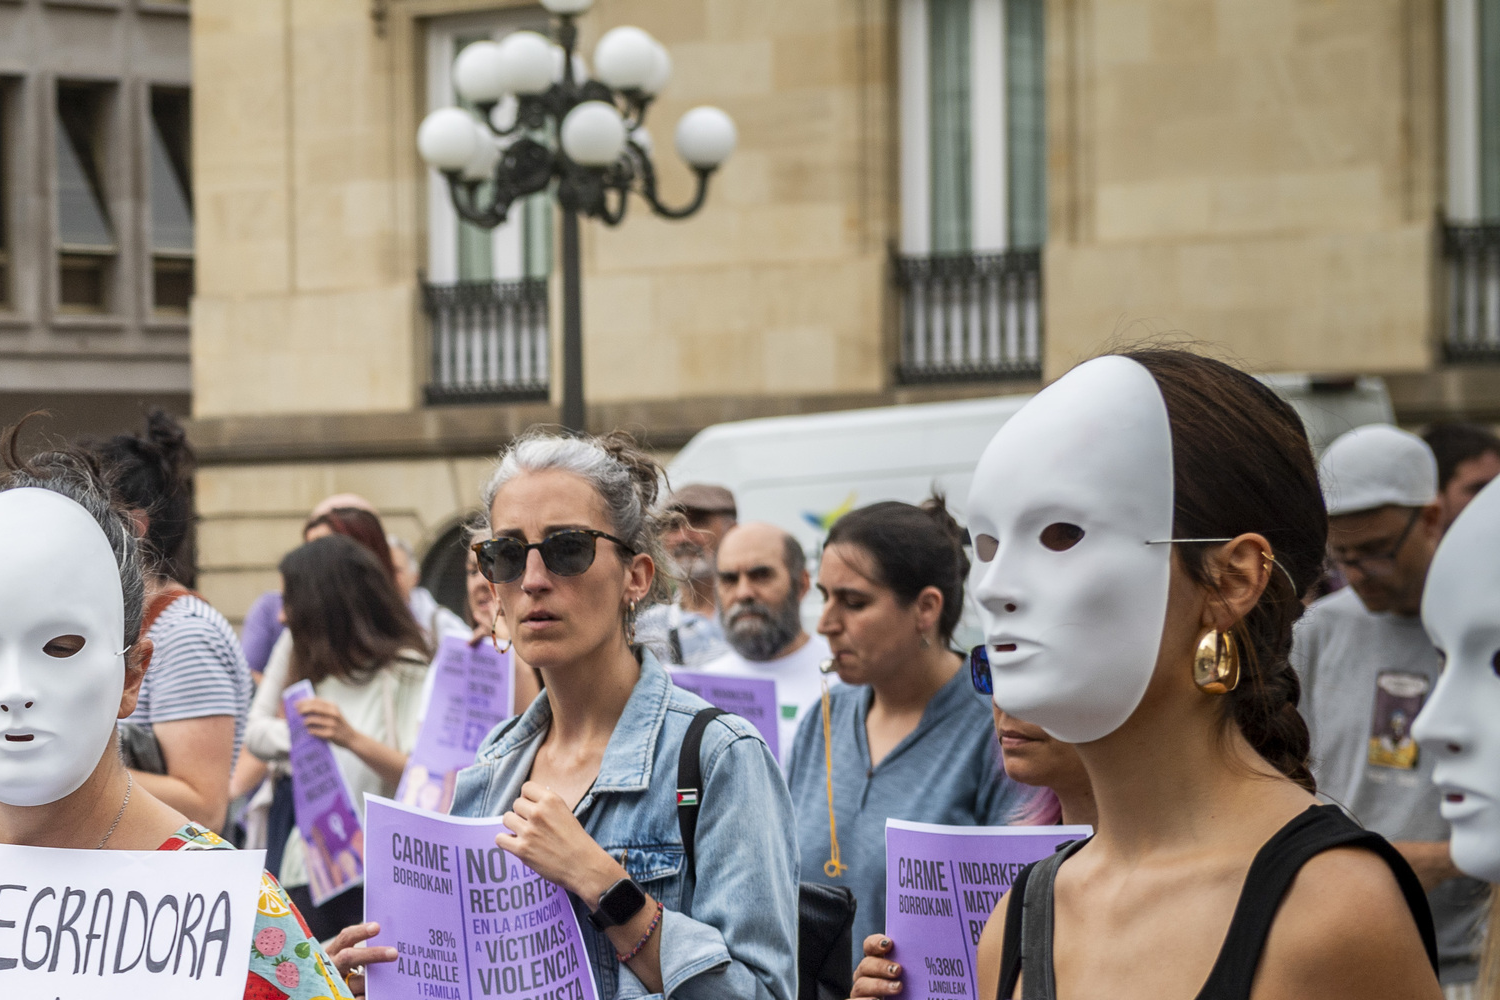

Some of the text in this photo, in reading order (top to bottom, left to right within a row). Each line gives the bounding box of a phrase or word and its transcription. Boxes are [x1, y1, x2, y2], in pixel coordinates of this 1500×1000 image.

[393, 832, 451, 873] CARME
[465, 848, 508, 884] NO
[511, 864, 520, 881] A
[899, 857, 948, 892] CARME
[393, 866, 453, 895] BORROKAN!
[899, 894, 953, 918] BORROKAN!
[429, 928, 456, 949] 38%
[473, 919, 491, 935] EN
[494, 917, 511, 934] LA
[397, 941, 458, 963] DE LA PLANTILLA
[475, 941, 483, 953] A
[485, 920, 567, 964] VÍCTIMAS
[397, 957, 460, 983] A LA CALLE
[477, 942, 580, 996] VIOLENCIA
[417, 982, 461, 1000] 1 FAMILIA
[928, 980, 967, 995] LANGILEAK
